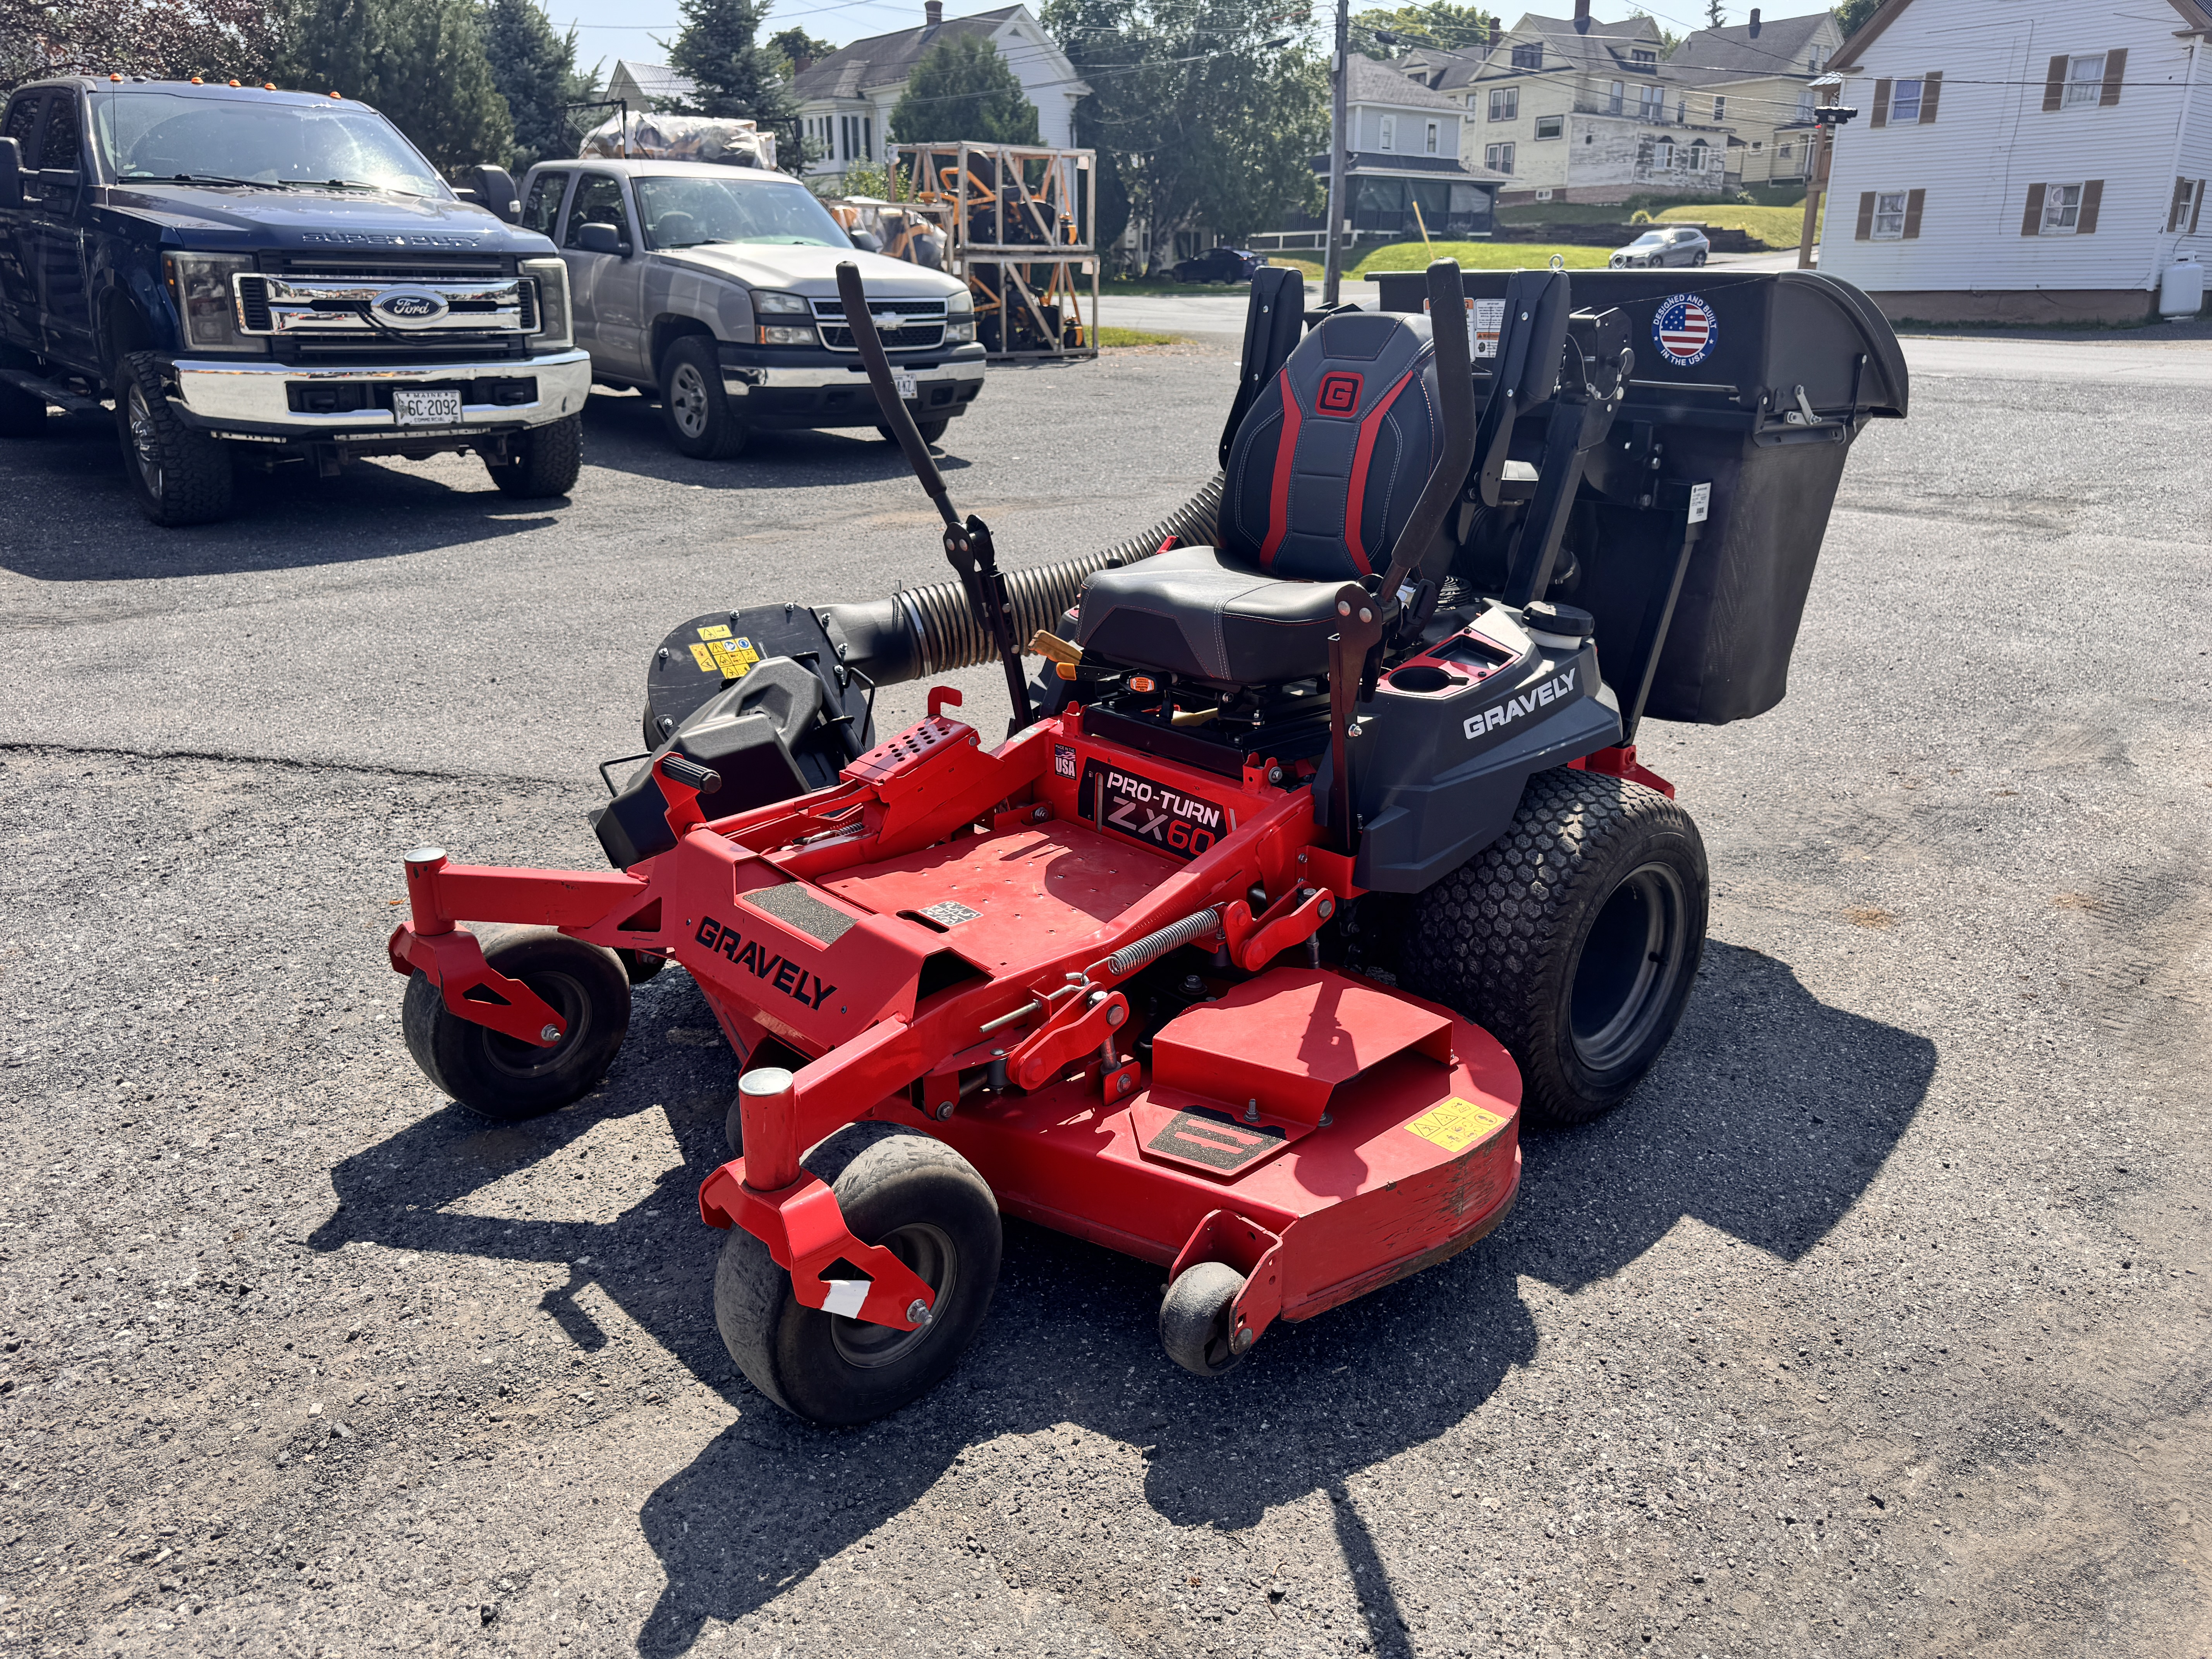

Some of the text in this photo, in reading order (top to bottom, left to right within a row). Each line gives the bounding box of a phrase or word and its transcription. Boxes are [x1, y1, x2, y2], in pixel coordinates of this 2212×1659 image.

[302, 233, 481, 247] SUPER DUTY
[393, 298, 429, 315] Ford
[1653, 294, 1717, 329] DESIGNED AND BUILT
[1661, 349, 1705, 366] IN THE USA
[1463, 668, 1575, 739] GRAVELY
[1055, 757, 1075, 777] USA
[1107, 772, 1220, 828] PRO-TURN
[1108, 796, 1215, 856] ZX60
[695, 915, 838, 1011] GRAVELY
